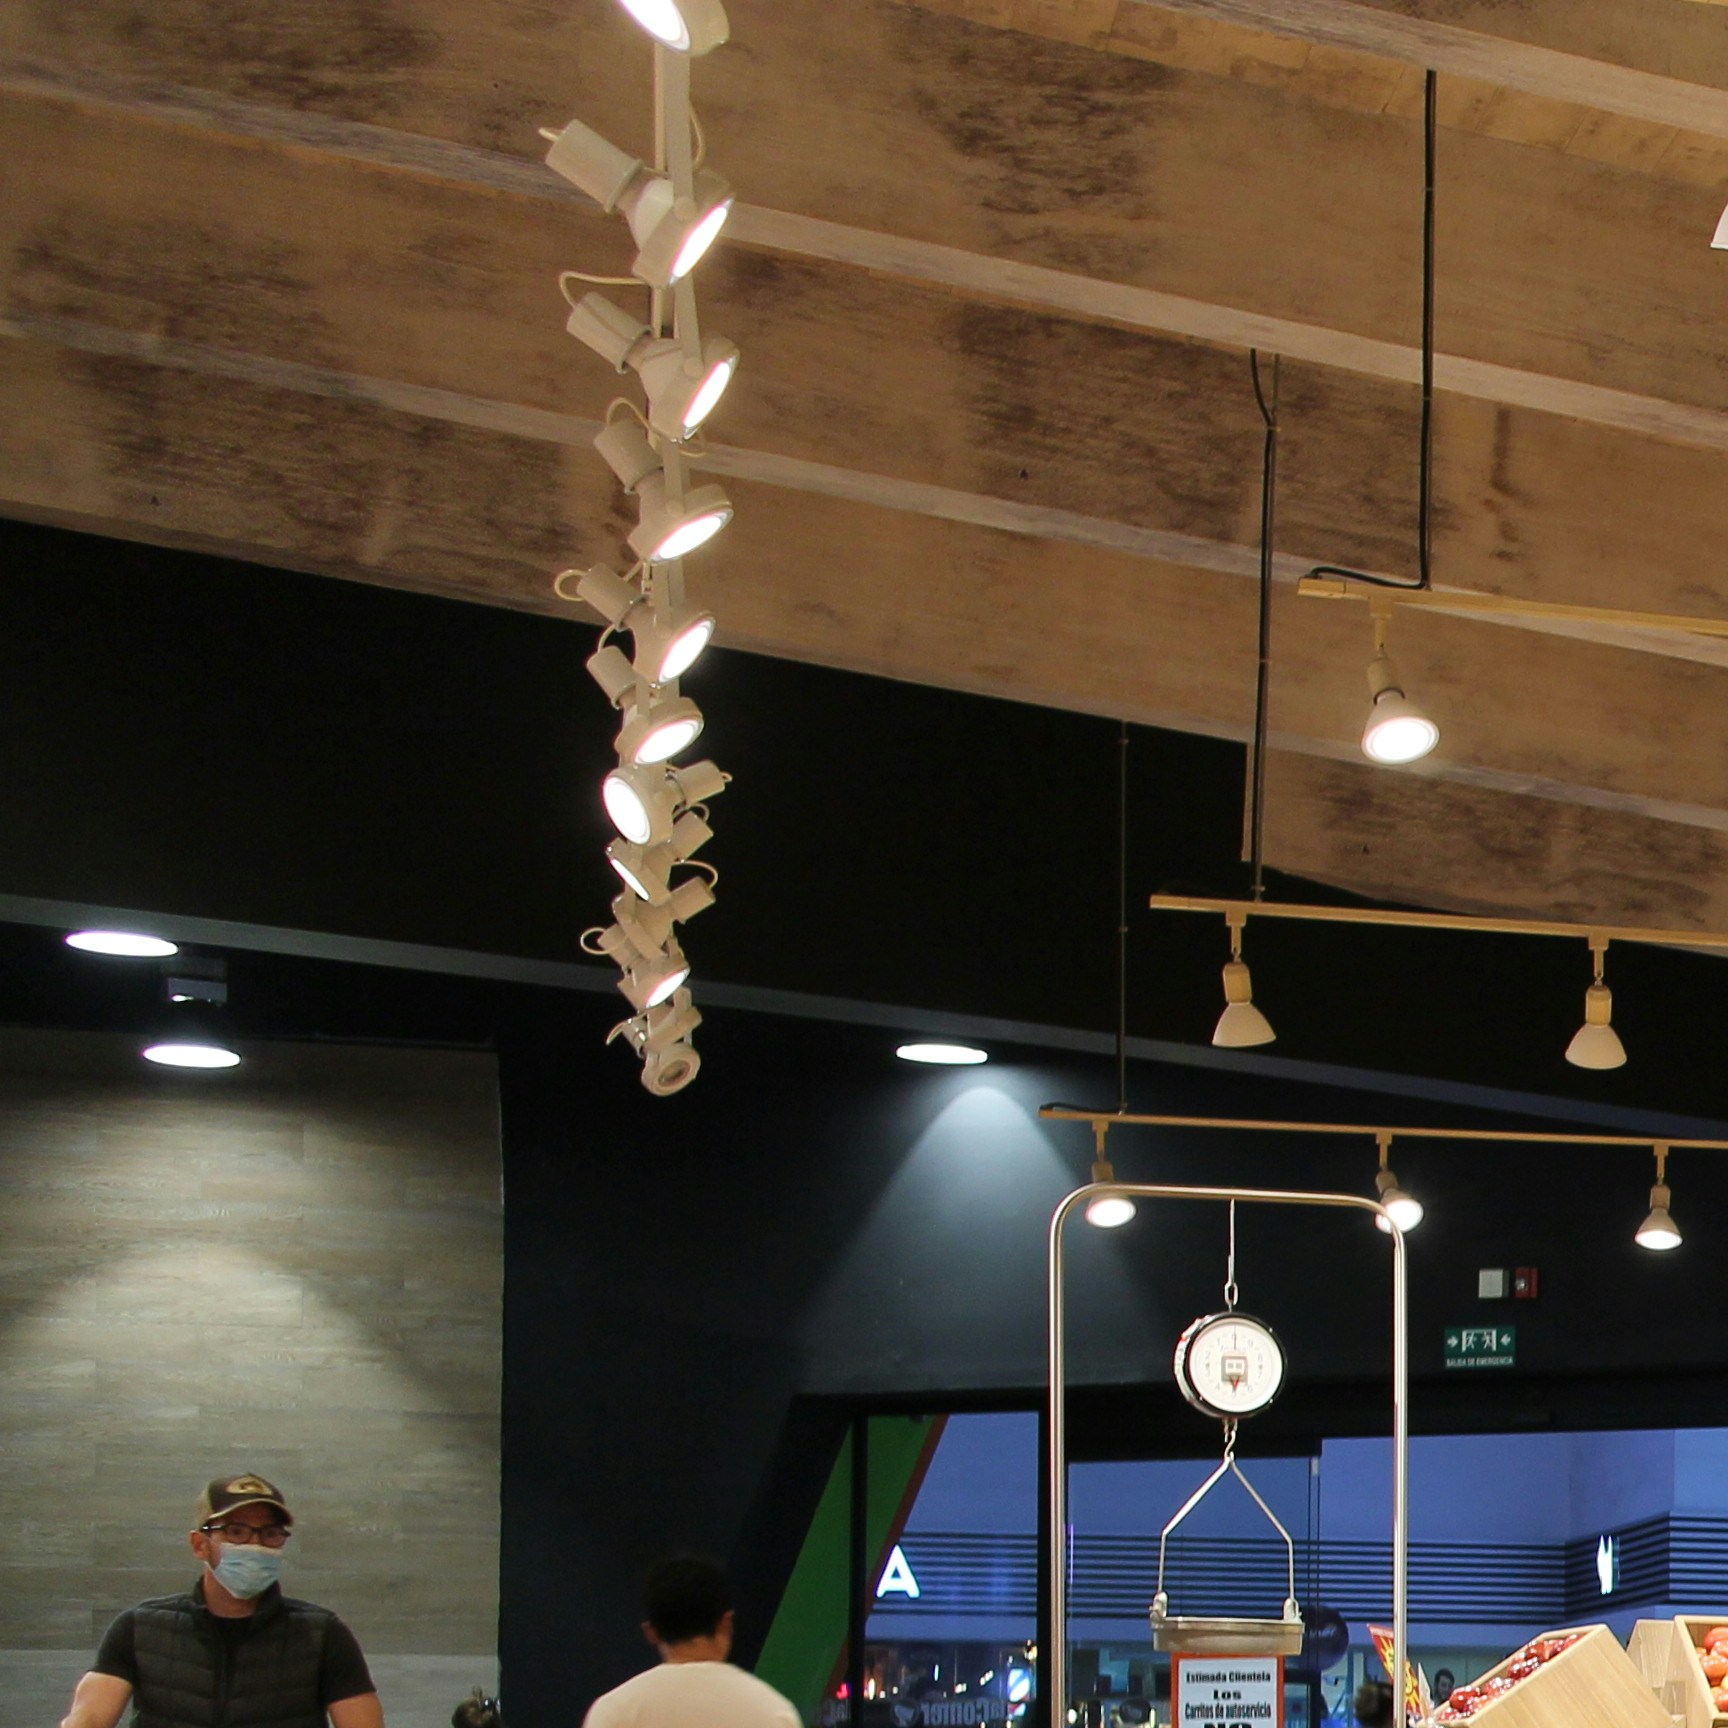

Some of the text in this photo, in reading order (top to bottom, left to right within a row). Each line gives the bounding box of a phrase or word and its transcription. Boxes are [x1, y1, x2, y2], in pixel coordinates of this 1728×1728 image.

[1186, 1670, 1271, 1684] Estimada Clientela
[1213, 1689, 1242, 1700] Los
[1185, 1702, 1272, 1720] Carritos de autoservicio
